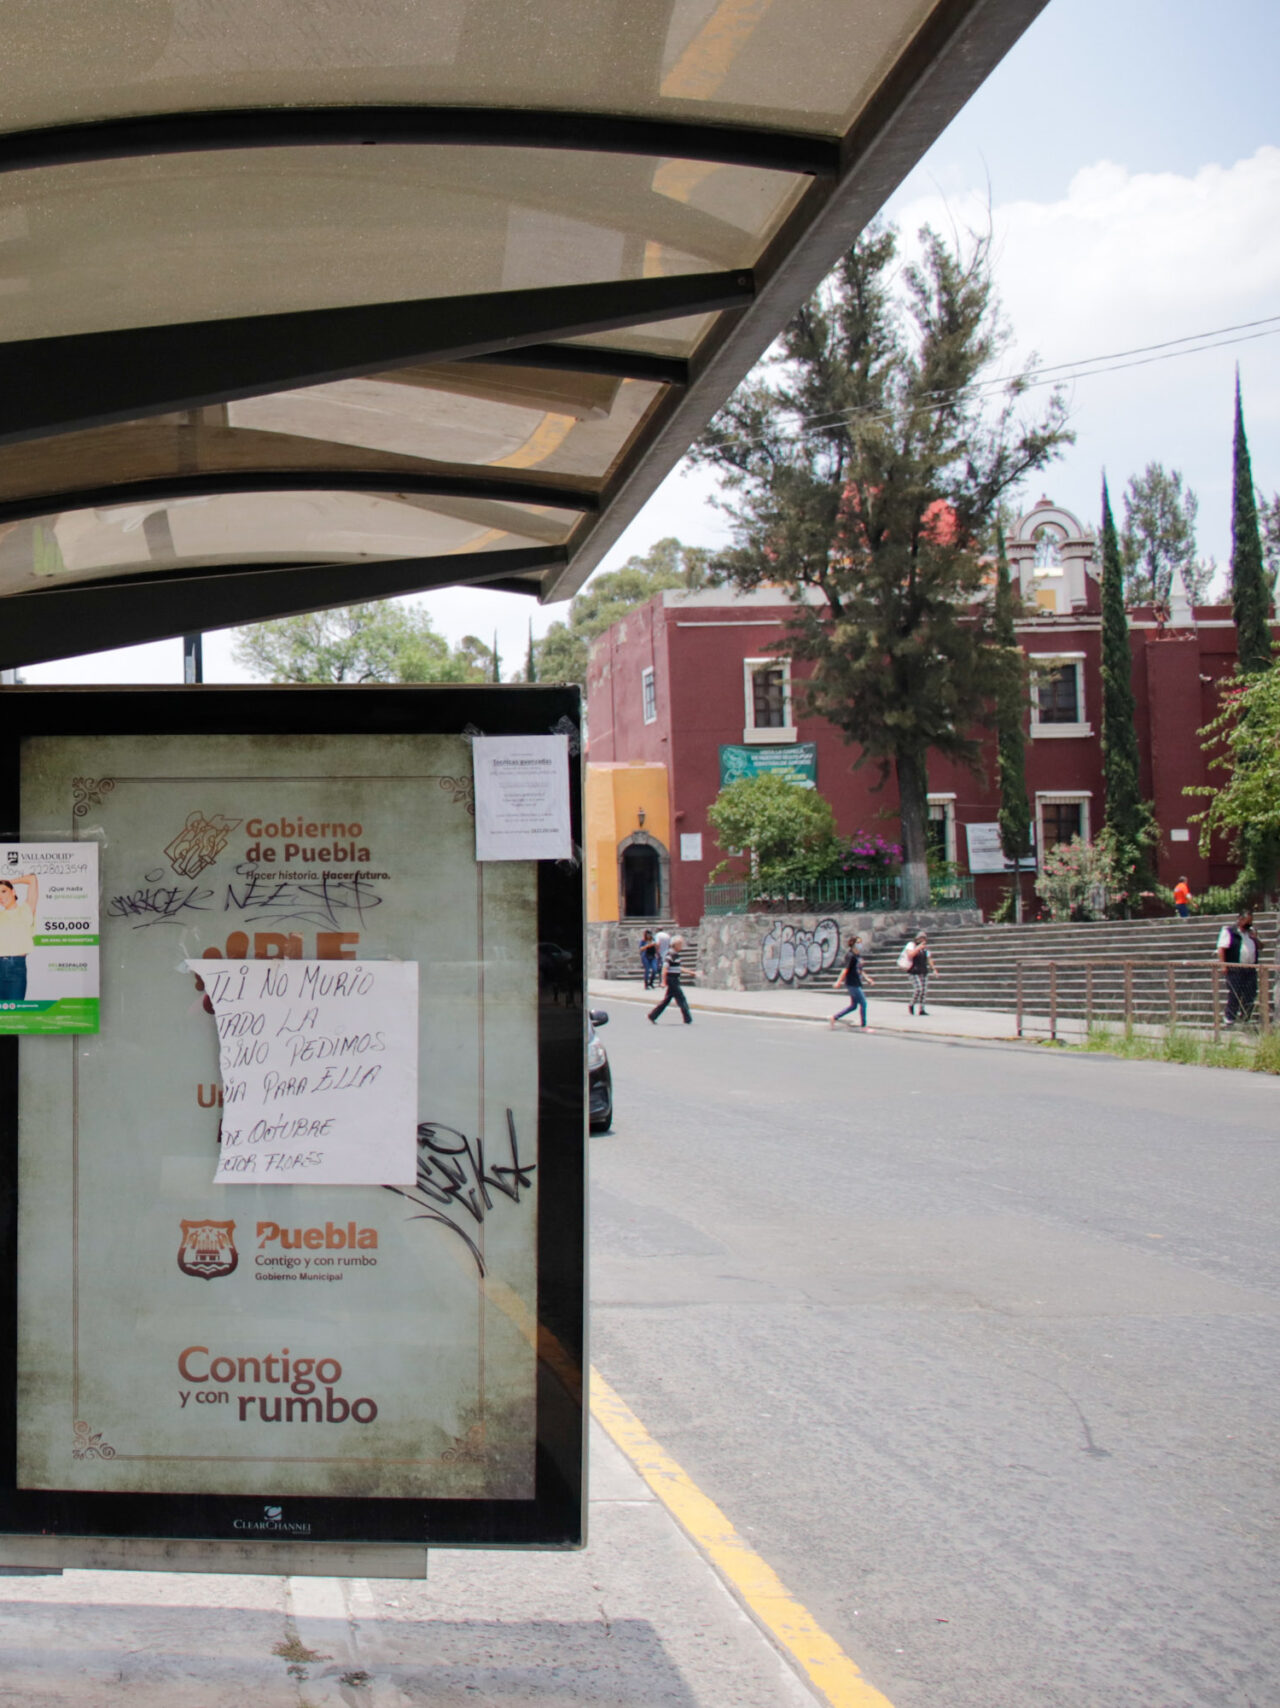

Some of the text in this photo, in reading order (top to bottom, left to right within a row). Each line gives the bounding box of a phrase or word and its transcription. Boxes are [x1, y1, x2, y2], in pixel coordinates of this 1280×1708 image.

[245, 816, 363, 839] Gobierno
[245, 842, 371, 862] de Puebla
[246, 871, 276, 880] Hacer
[278, 870, 319, 880] historia.
[322, 870, 353, 880] Hacer
[45, 921, 90, 931] $50,000
[260, 964, 288, 998] NO
[276, 1007, 318, 1036] LA
[286, 1031, 386, 1066] PEDIMOS
[311, 1065, 382, 1093] ELLA
[256, 1221, 378, 1249] Puebla
[255, 1254, 377, 1268] Contigo y con rumbo
[255, 1272, 343, 1282] Gobierno Municipal
[177, 1345, 342, 1395] Contigo
[179, 1387, 378, 1424] y con rumbo
